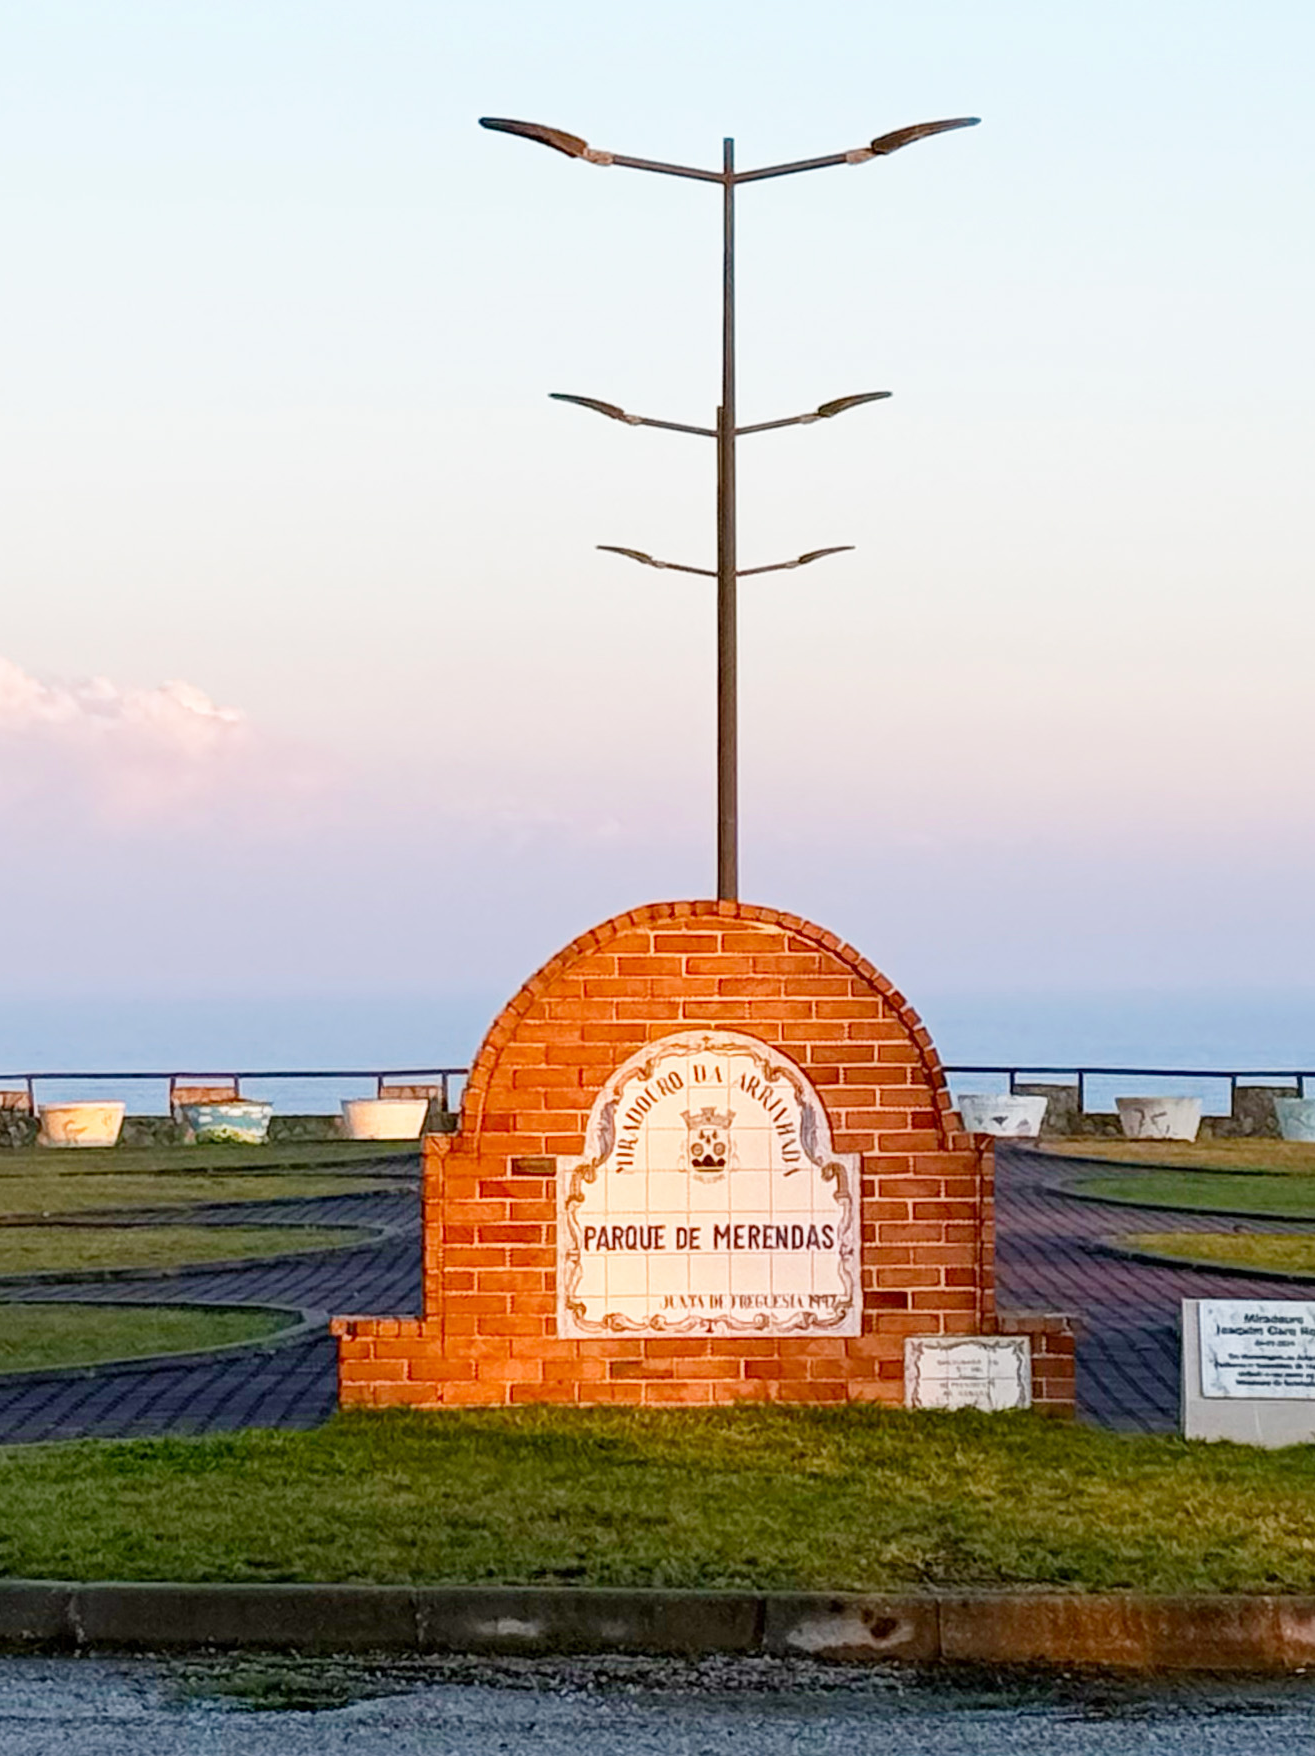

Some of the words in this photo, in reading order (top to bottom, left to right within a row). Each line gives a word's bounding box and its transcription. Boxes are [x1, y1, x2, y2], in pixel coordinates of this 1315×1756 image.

[615, 1071, 684, 1174] MIRADOURO
[693, 1064, 723, 1084] DA
[584, 1224, 666, 1252] PARQUE
[676, 1226, 702, 1251] DE
[714, 1224, 835, 1251] MERENDAS
[661, 1294, 704, 1310] JUNTA
[709, 1294, 726, 1310] DE
[730, 1294, 803, 1310] FREGUESIA
